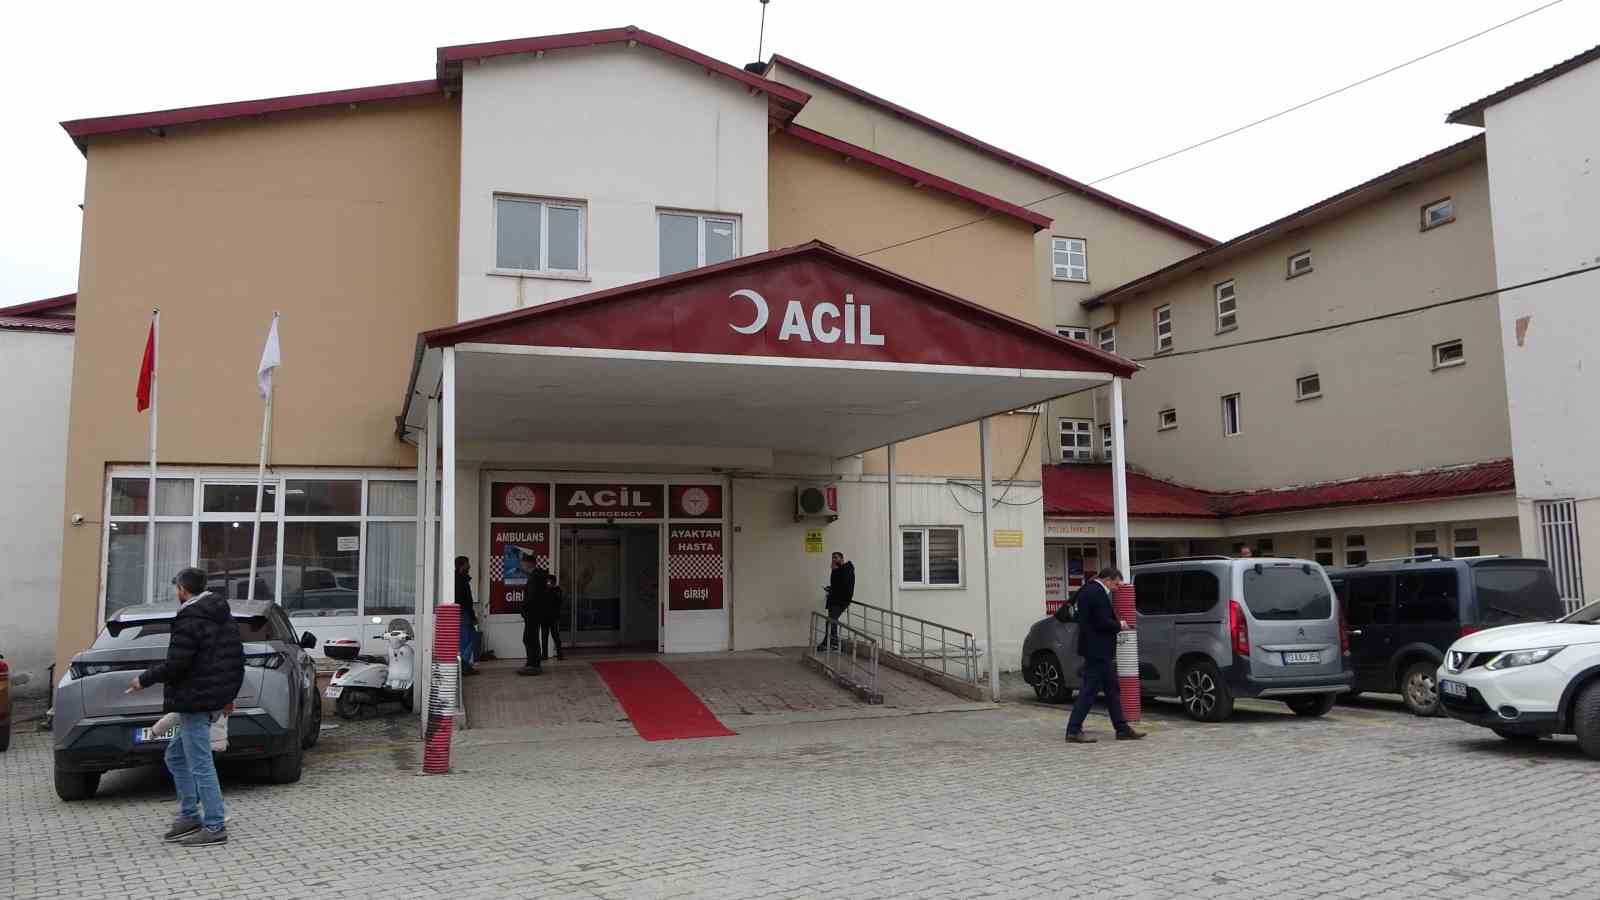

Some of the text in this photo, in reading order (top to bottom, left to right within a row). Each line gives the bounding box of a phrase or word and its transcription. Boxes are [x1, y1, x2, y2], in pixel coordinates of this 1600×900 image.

[778, 293, 885, 346] ACİL
[568, 488, 652, 507] ACİL
[496, 532, 545, 543] AMBULANS
[671, 529, 721, 538] AYAKTAN
[678, 543, 714, 551] HASTA
